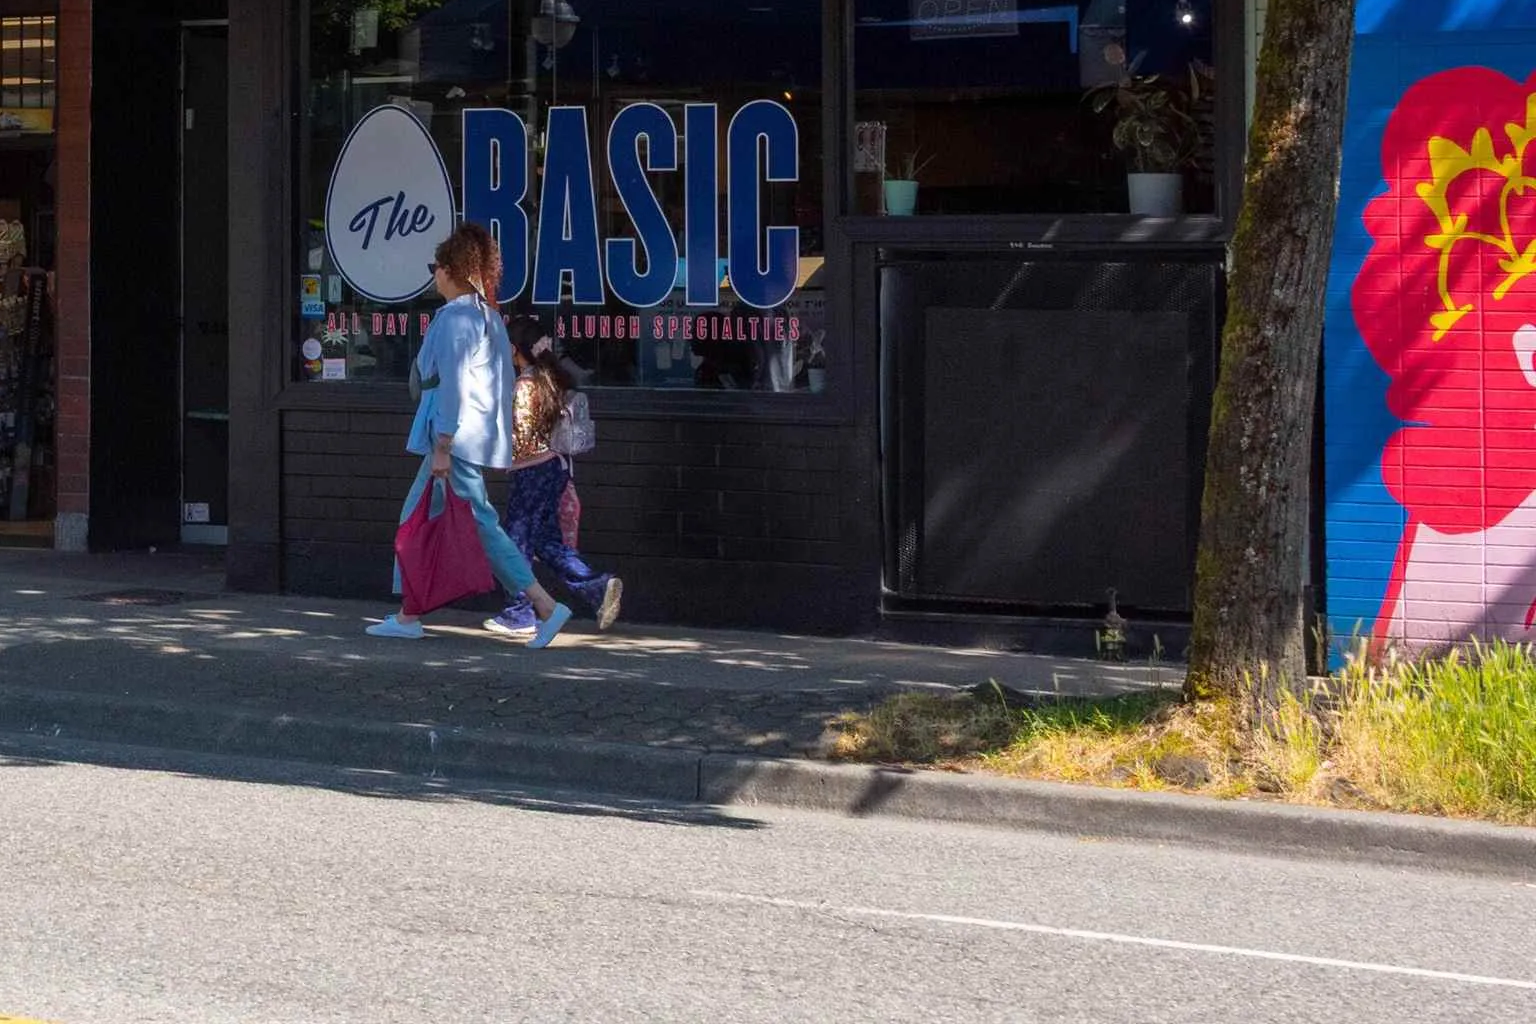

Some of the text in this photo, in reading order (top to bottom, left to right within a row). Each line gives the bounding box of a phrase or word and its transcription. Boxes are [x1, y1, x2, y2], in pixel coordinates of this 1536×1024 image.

[349, 99, 800, 309] The BASIC
[304, 303, 324, 313] VISA
[327, 312, 361, 336] ALL
[372, 312, 409, 336] DAY
[572, 315, 640, 339] LUNCH
[653, 316, 801, 342] SPECIALTIES
